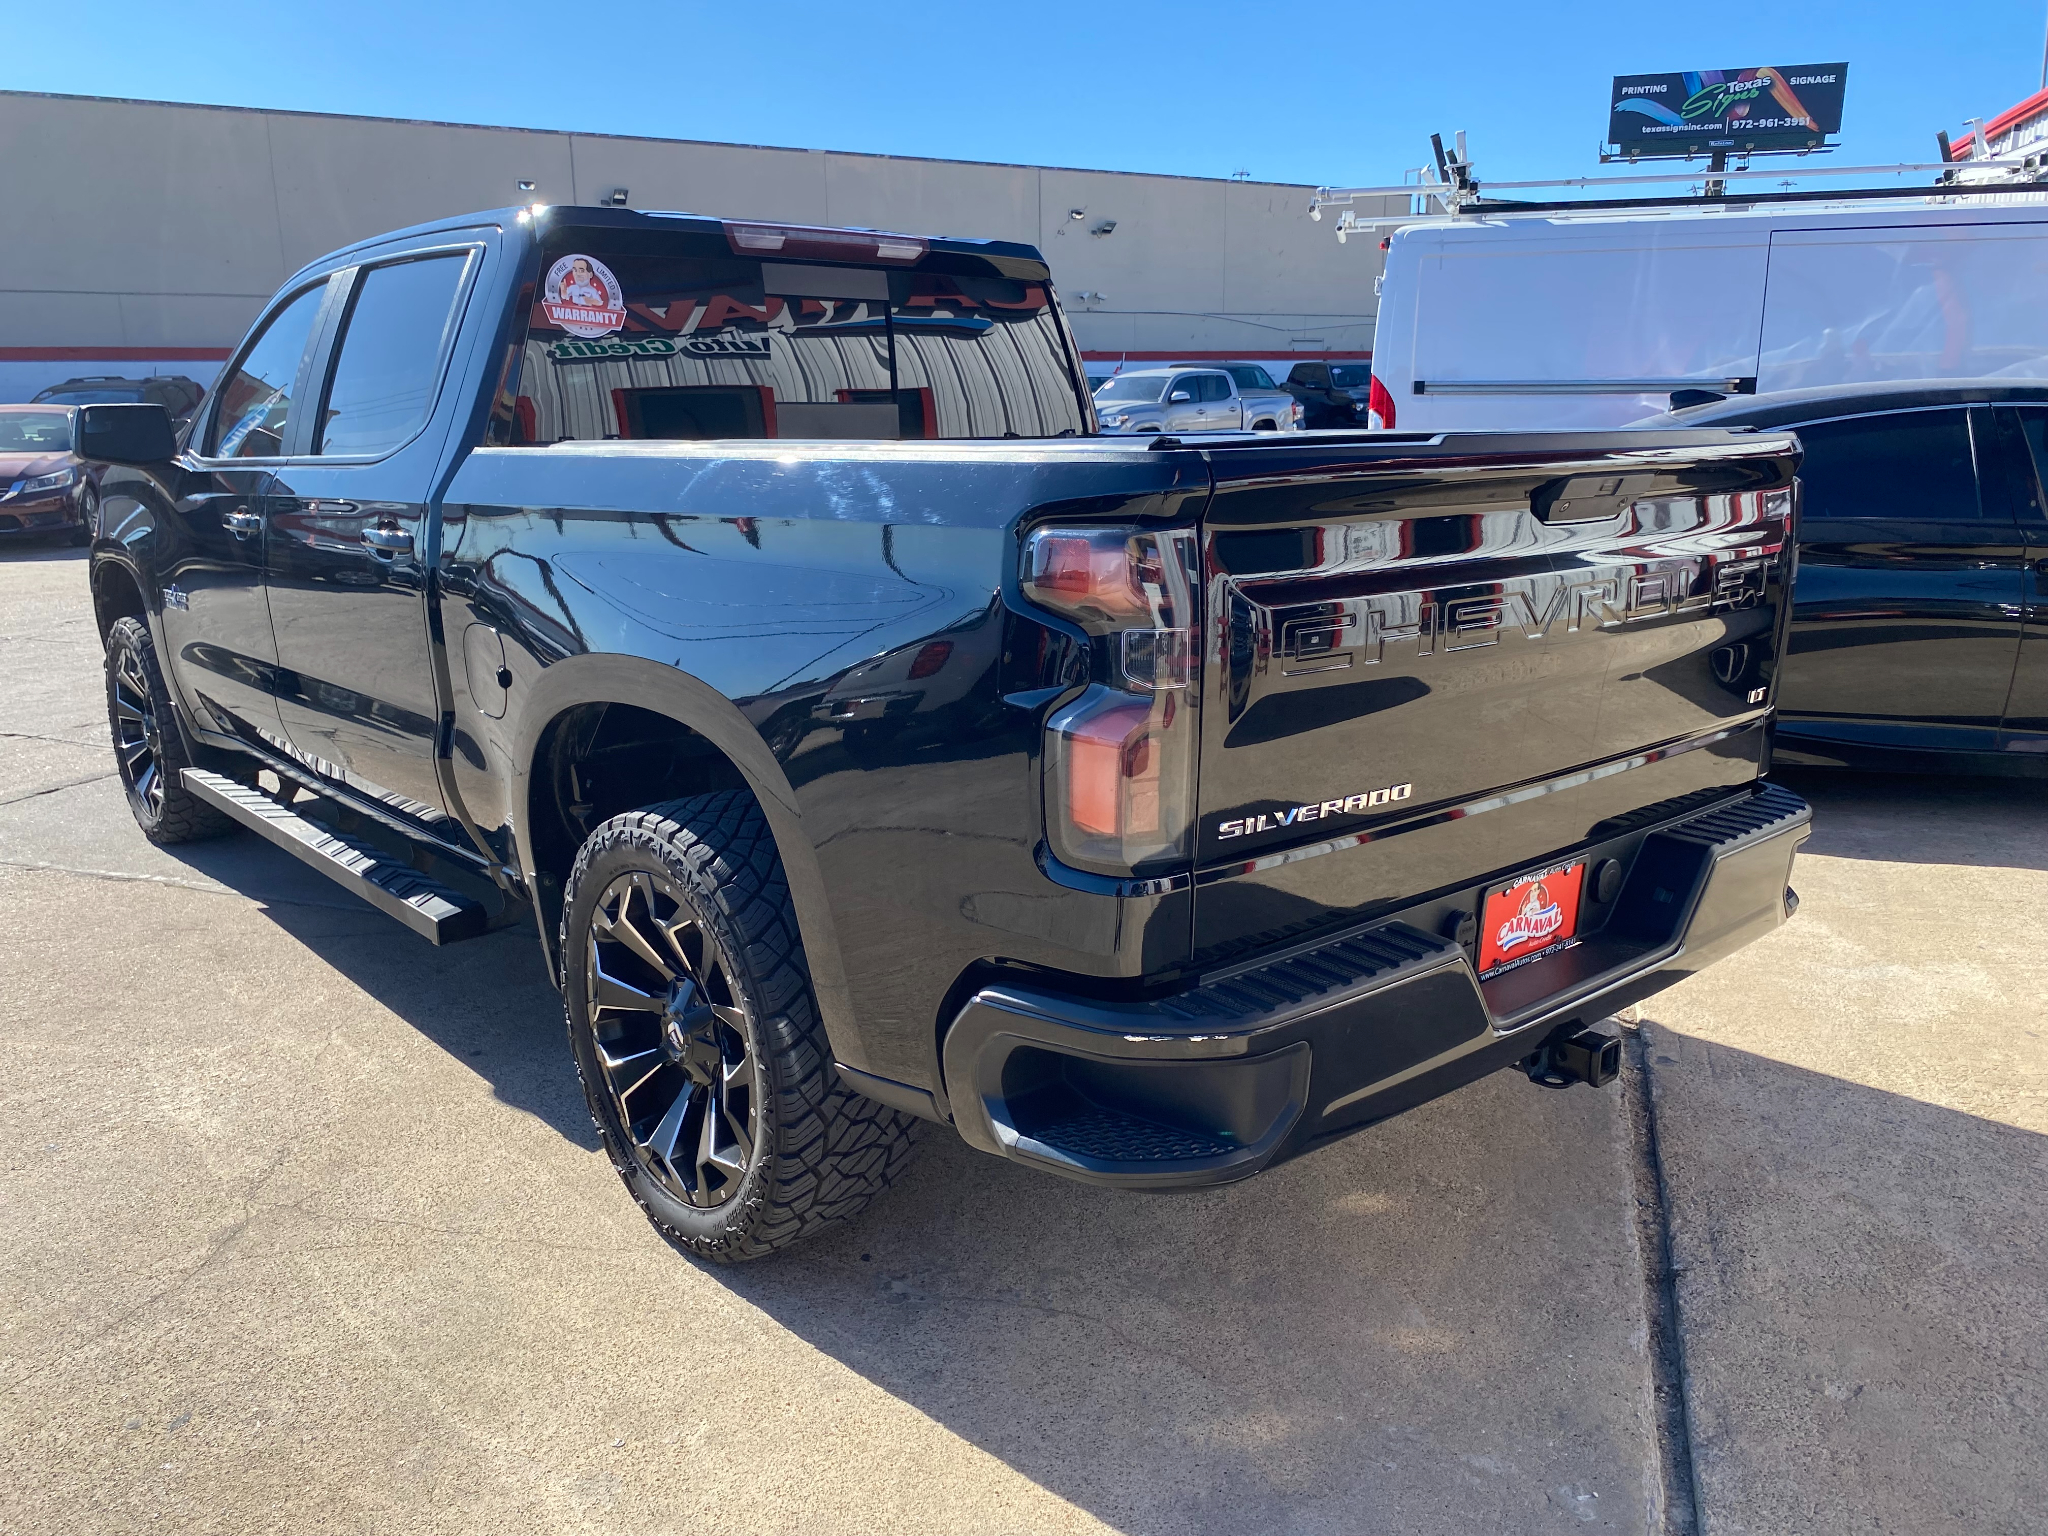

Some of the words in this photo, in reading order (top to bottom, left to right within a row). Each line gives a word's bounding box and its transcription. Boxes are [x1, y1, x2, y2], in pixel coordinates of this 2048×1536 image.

[1622, 84, 1668, 95] PRINTING
[1727, 77, 1771, 93] Texas
[1790, 75, 1836, 85] SIGNAGE
[1681, 83, 1760, 118] Signs
[1642, 123, 1722, 133] texassignsinc.com
[1732, 117, 1810, 129] 972-961-3951
[554, 262, 568, 277] FREE
[596, 266, 616, 290] LIMITED
[552, 306, 617, 325] WARRANTY
[1282, 552, 1778, 677] CHEVROLET
[1218, 782, 1412, 840] SILVERADO
[1497, 909, 1561, 943] CARNAVAL
